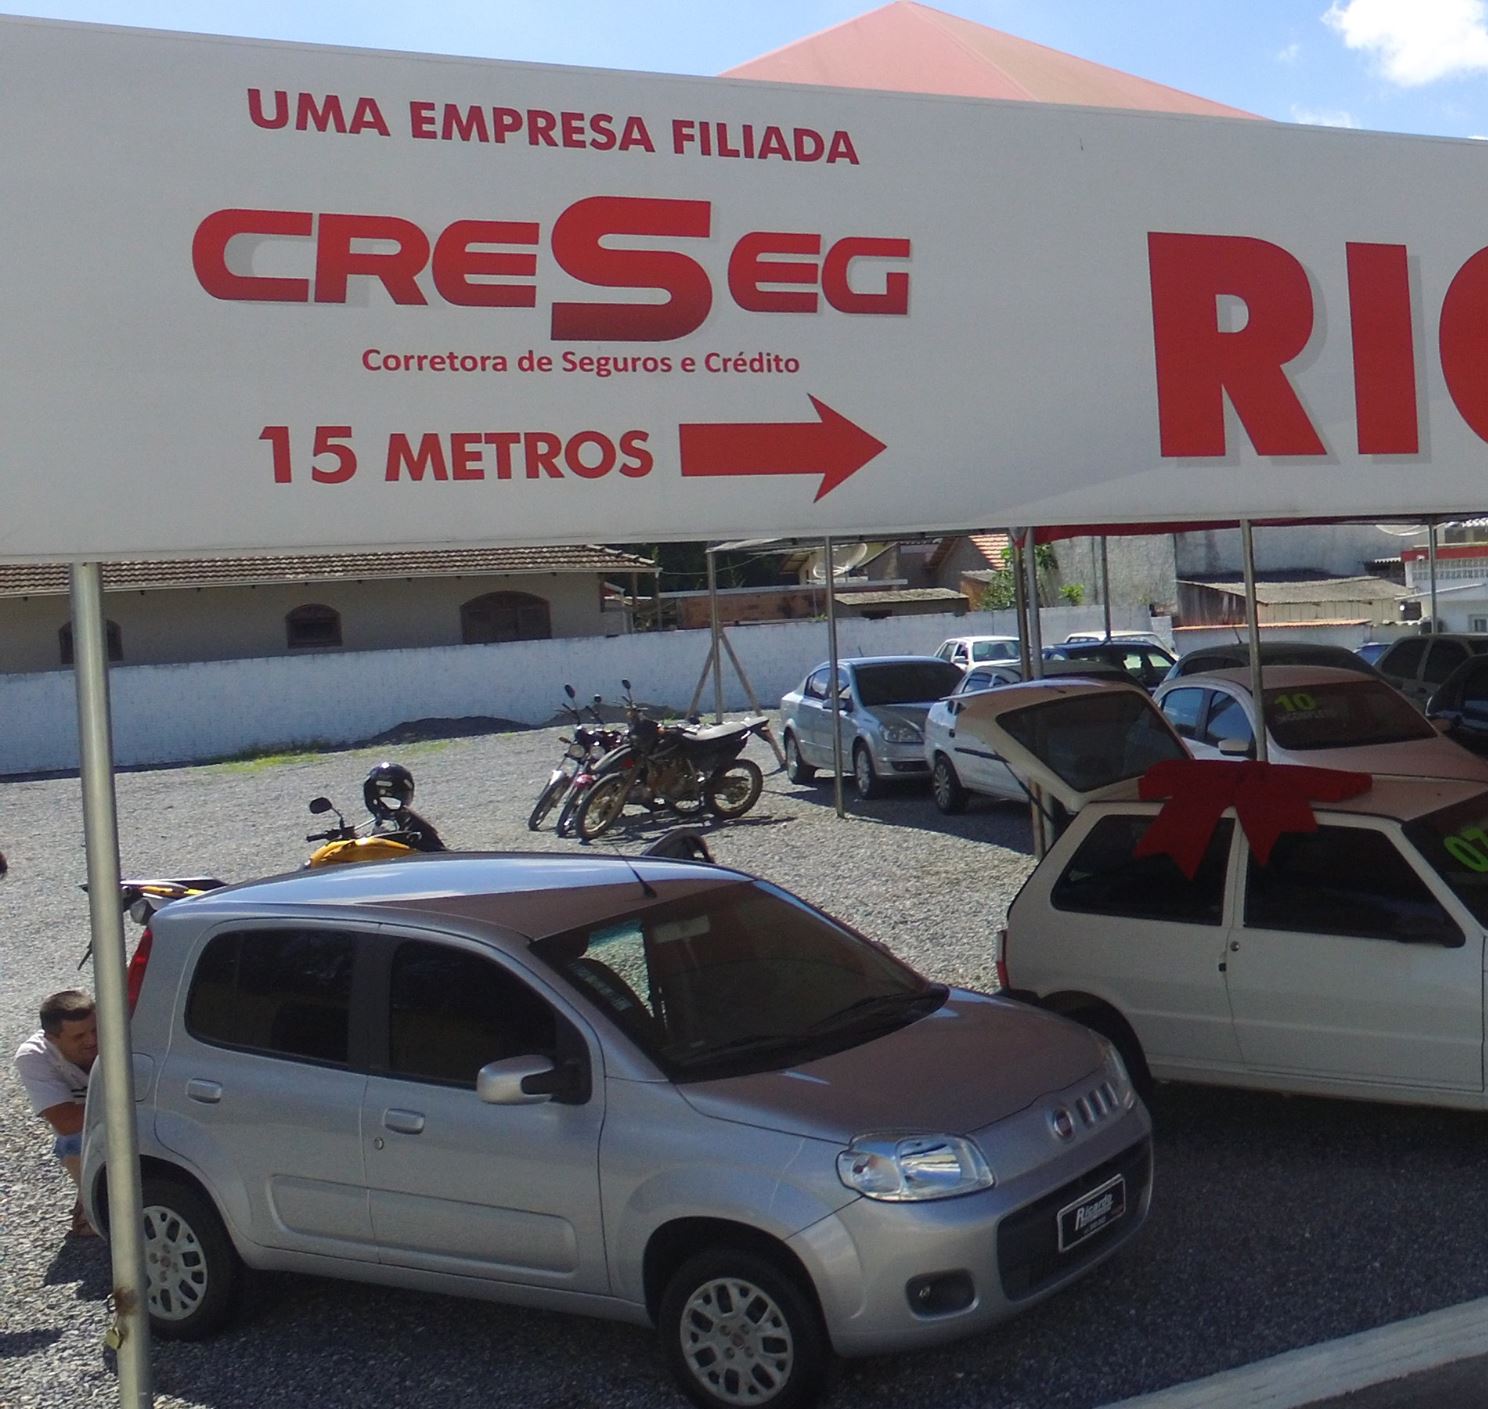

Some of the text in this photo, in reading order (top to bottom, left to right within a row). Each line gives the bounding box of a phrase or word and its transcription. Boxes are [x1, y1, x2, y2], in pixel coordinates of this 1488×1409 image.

[247, 88, 860, 165] UMA EMPRESA FILIADA
[362, 348, 800, 377] Corretora de Seguros e Crédito
[258, 425, 654, 484] 15 METROS
